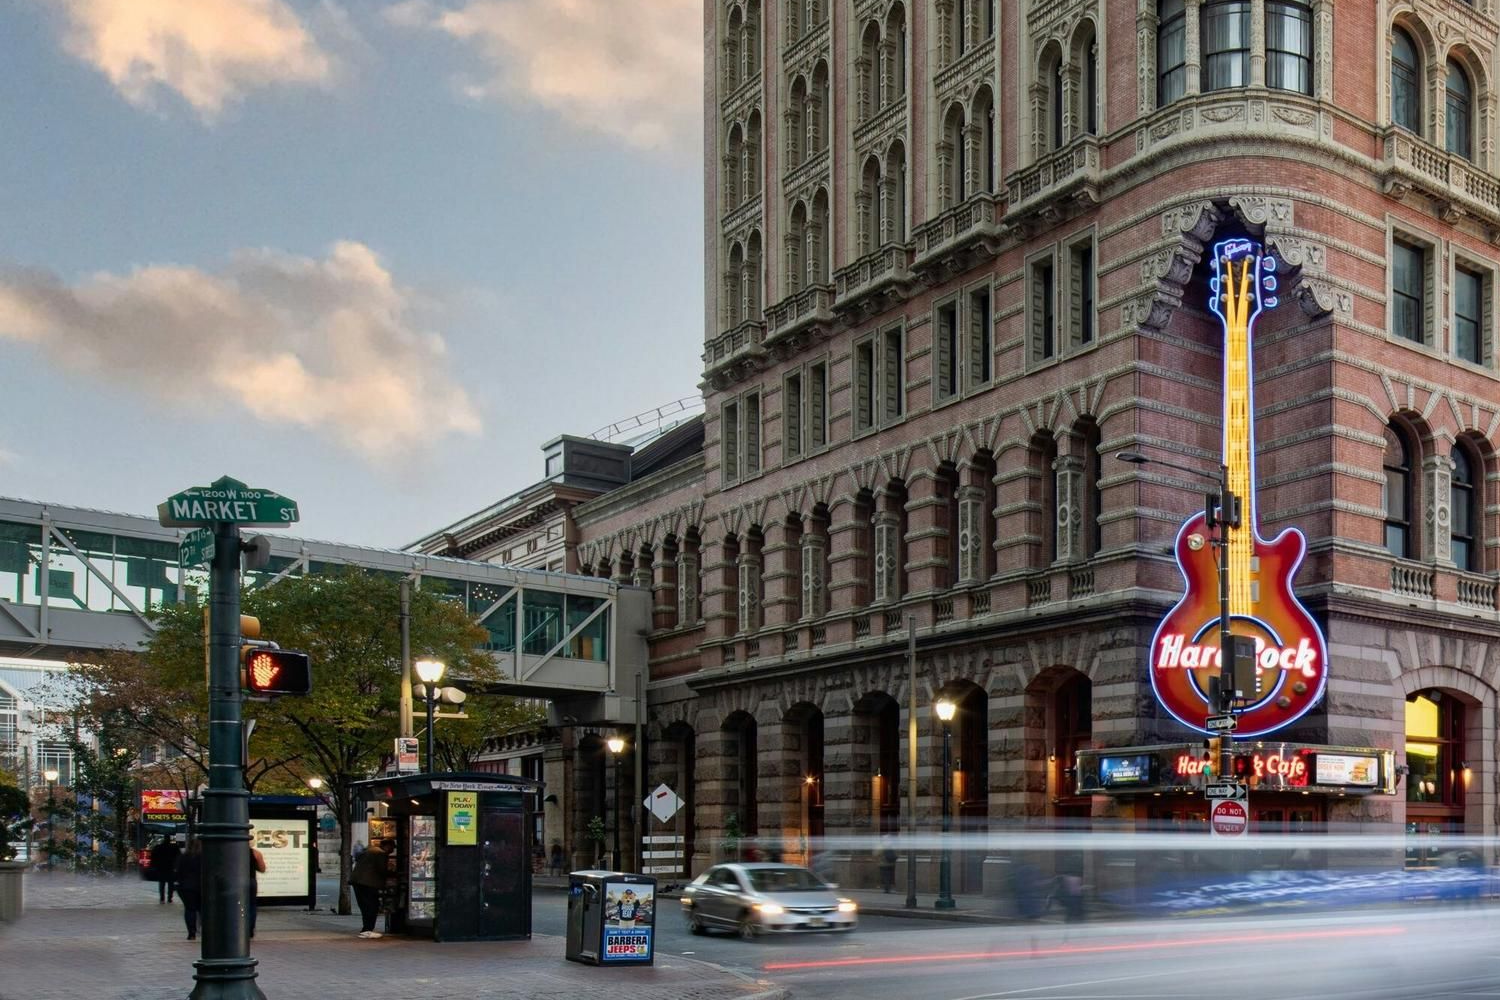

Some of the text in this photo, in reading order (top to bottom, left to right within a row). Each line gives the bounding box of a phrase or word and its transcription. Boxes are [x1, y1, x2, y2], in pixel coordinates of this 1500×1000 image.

[201, 489, 261, 499] 1200 W 1100
[172, 500, 296, 520] MARKET ST
[608, 936, 648, 945] BARBERA
